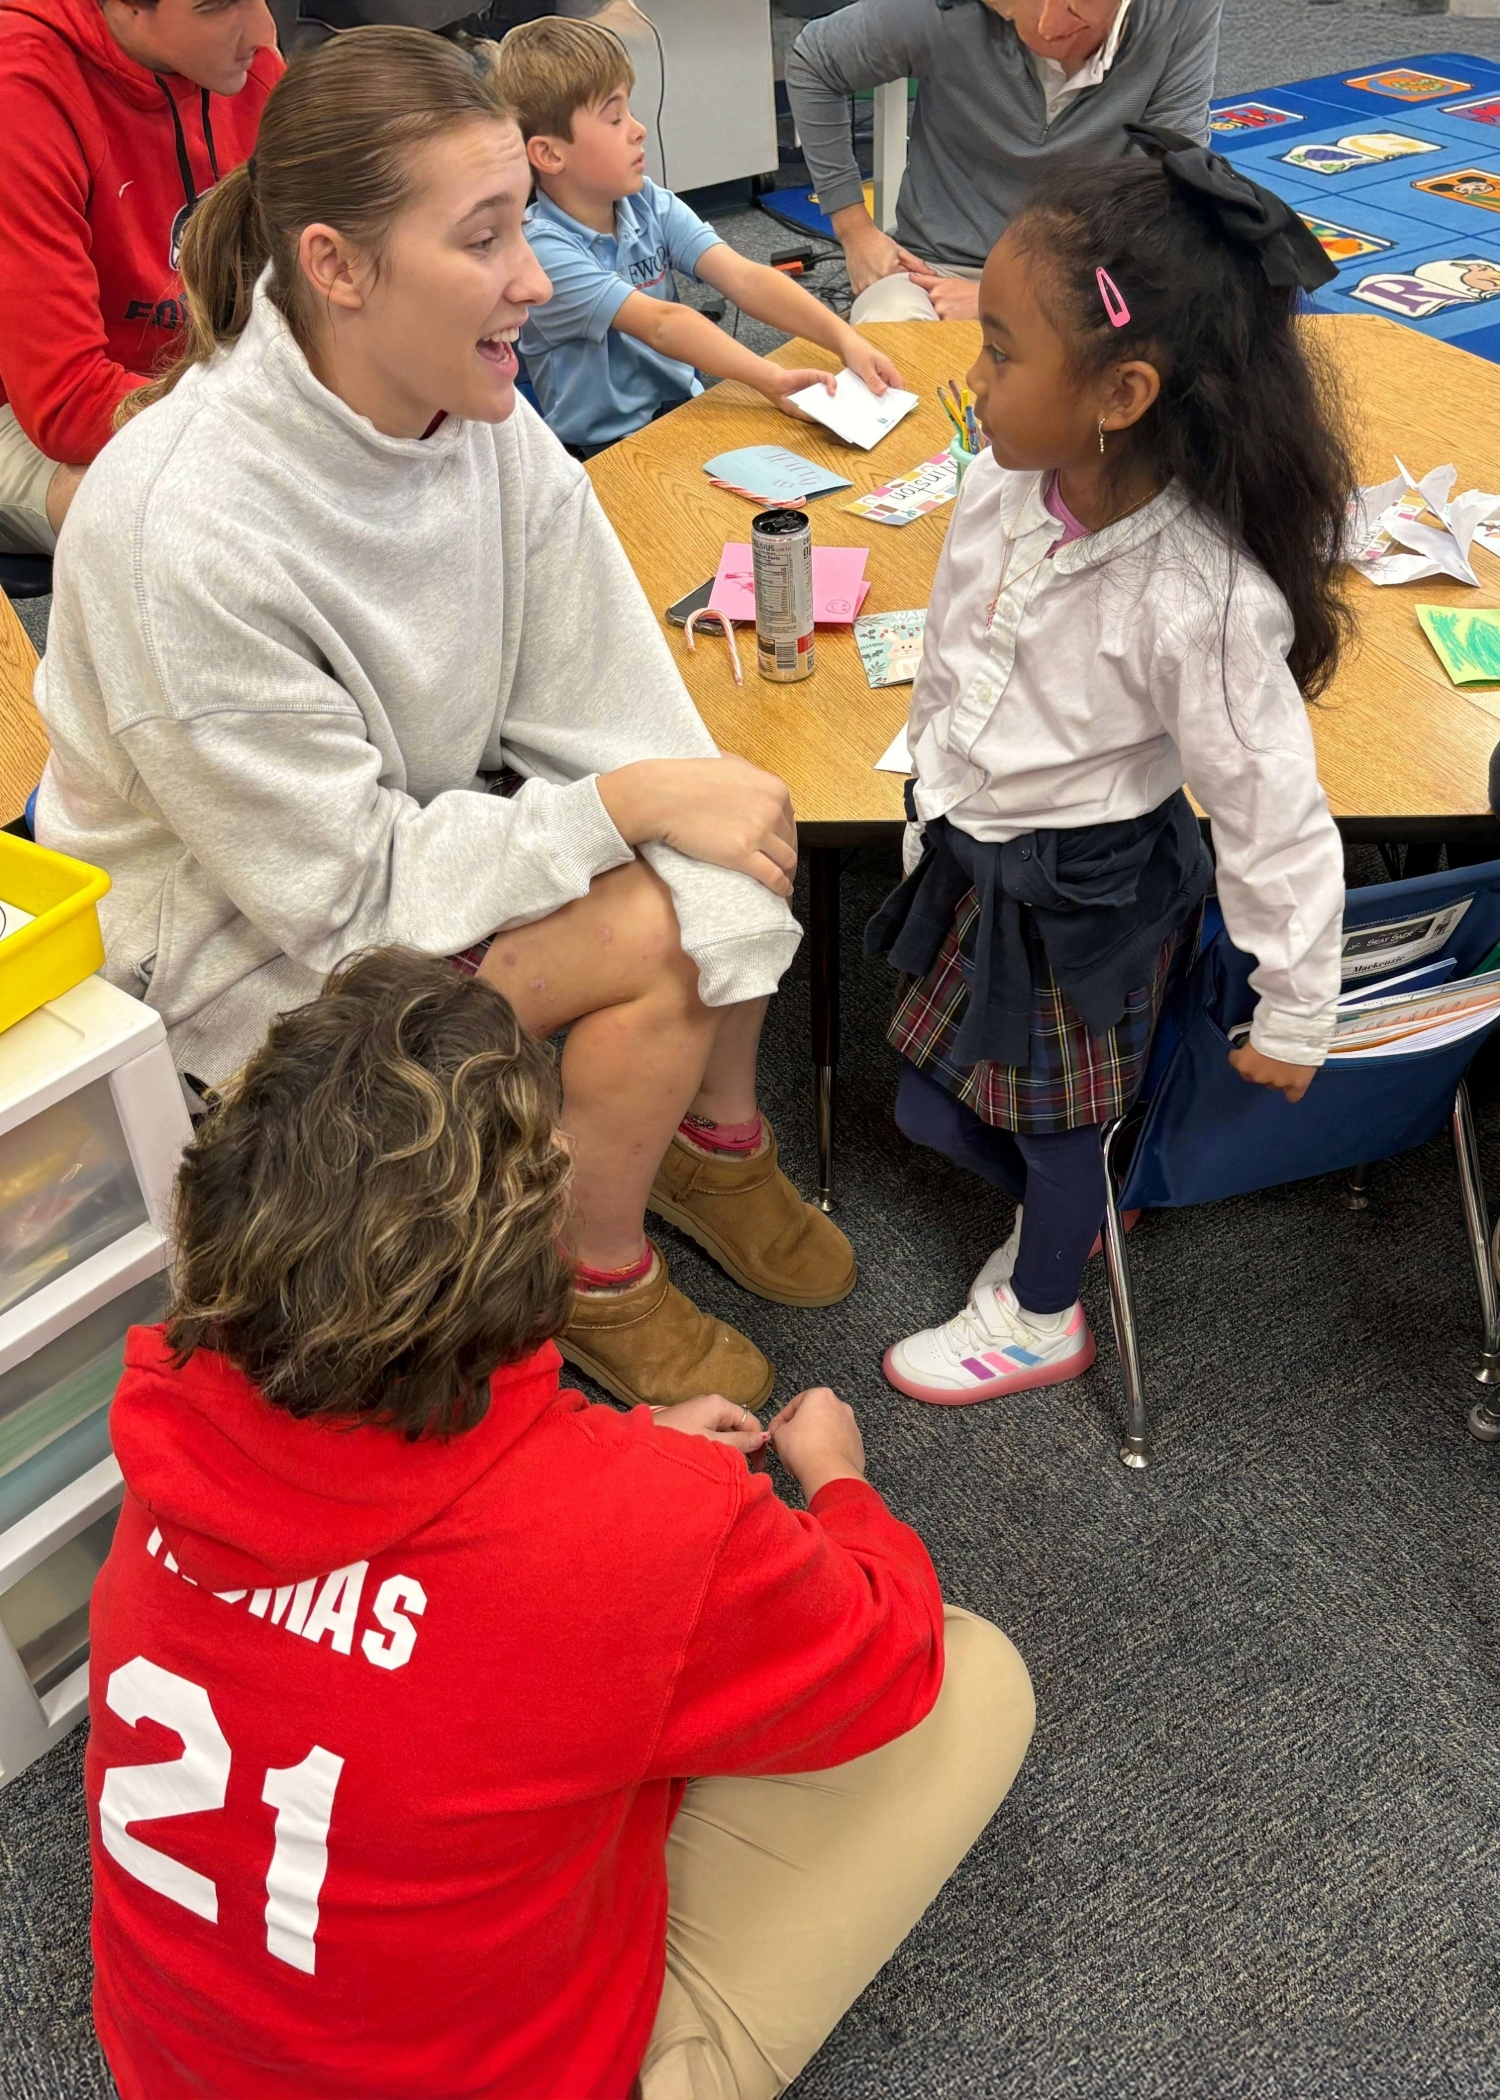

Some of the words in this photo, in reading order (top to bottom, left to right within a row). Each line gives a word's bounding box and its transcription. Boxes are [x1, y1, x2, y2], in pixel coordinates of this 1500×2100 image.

[1359, 279, 1468, 313] R
[752, 539, 775, 551] ELSIUS
[99, 1655, 346, 1976] 21
